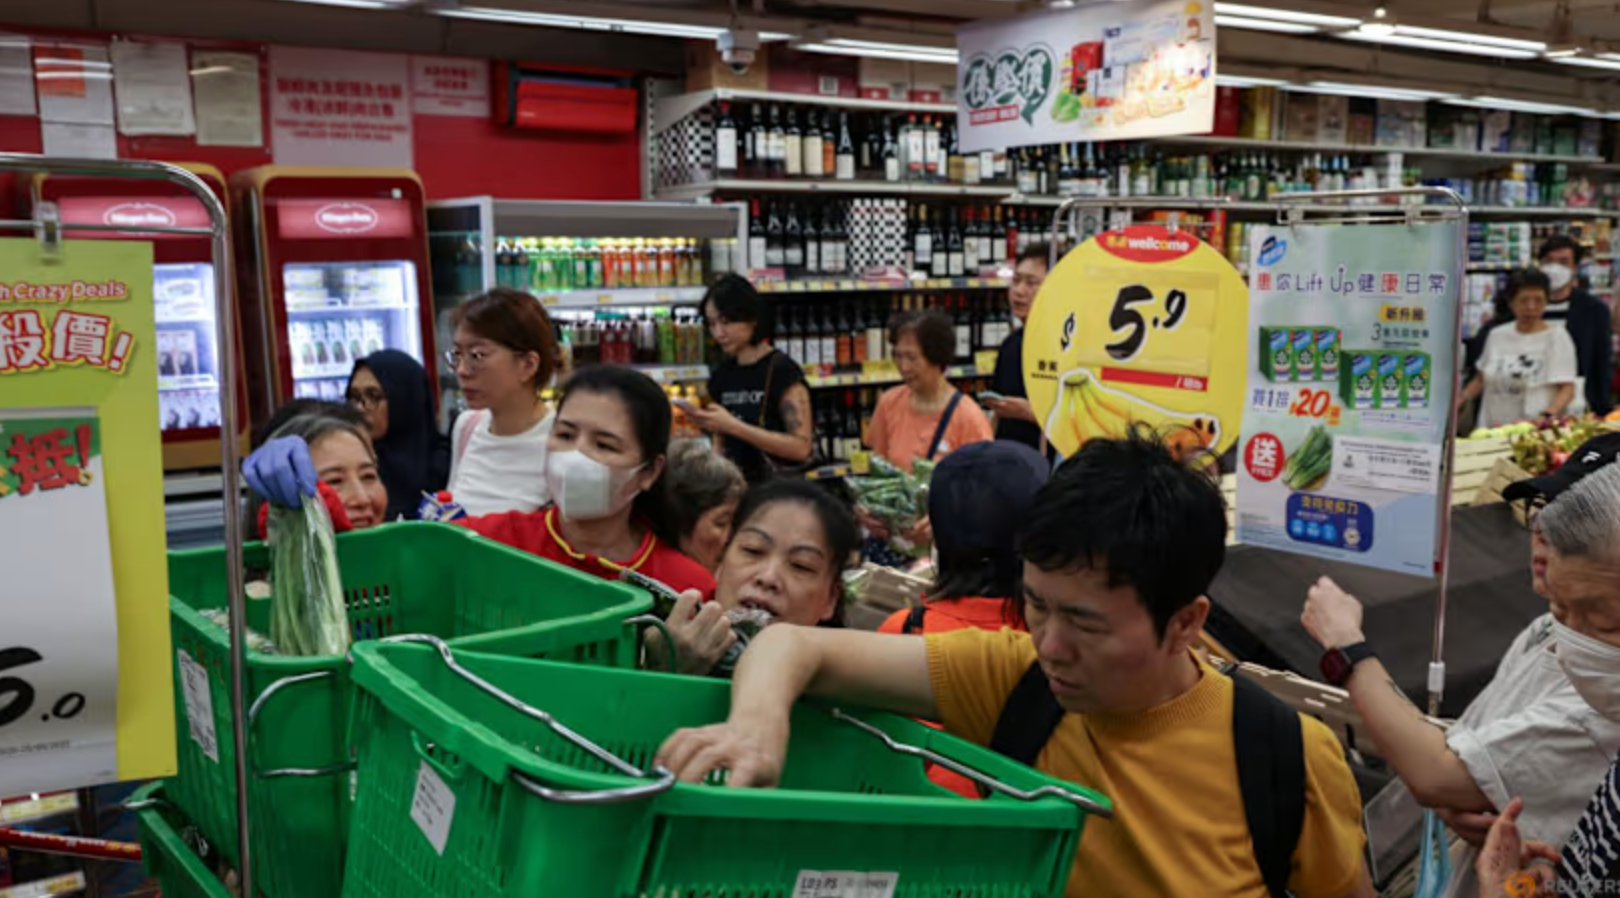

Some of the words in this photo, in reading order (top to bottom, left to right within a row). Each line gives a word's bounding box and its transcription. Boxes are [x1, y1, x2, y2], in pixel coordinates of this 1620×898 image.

[1129, 236, 1189, 252] wellcome
[14, 283, 69, 302] Crazy
[72, 281, 126, 298] Deals
[1105, 285, 1186, 360] 5.9
